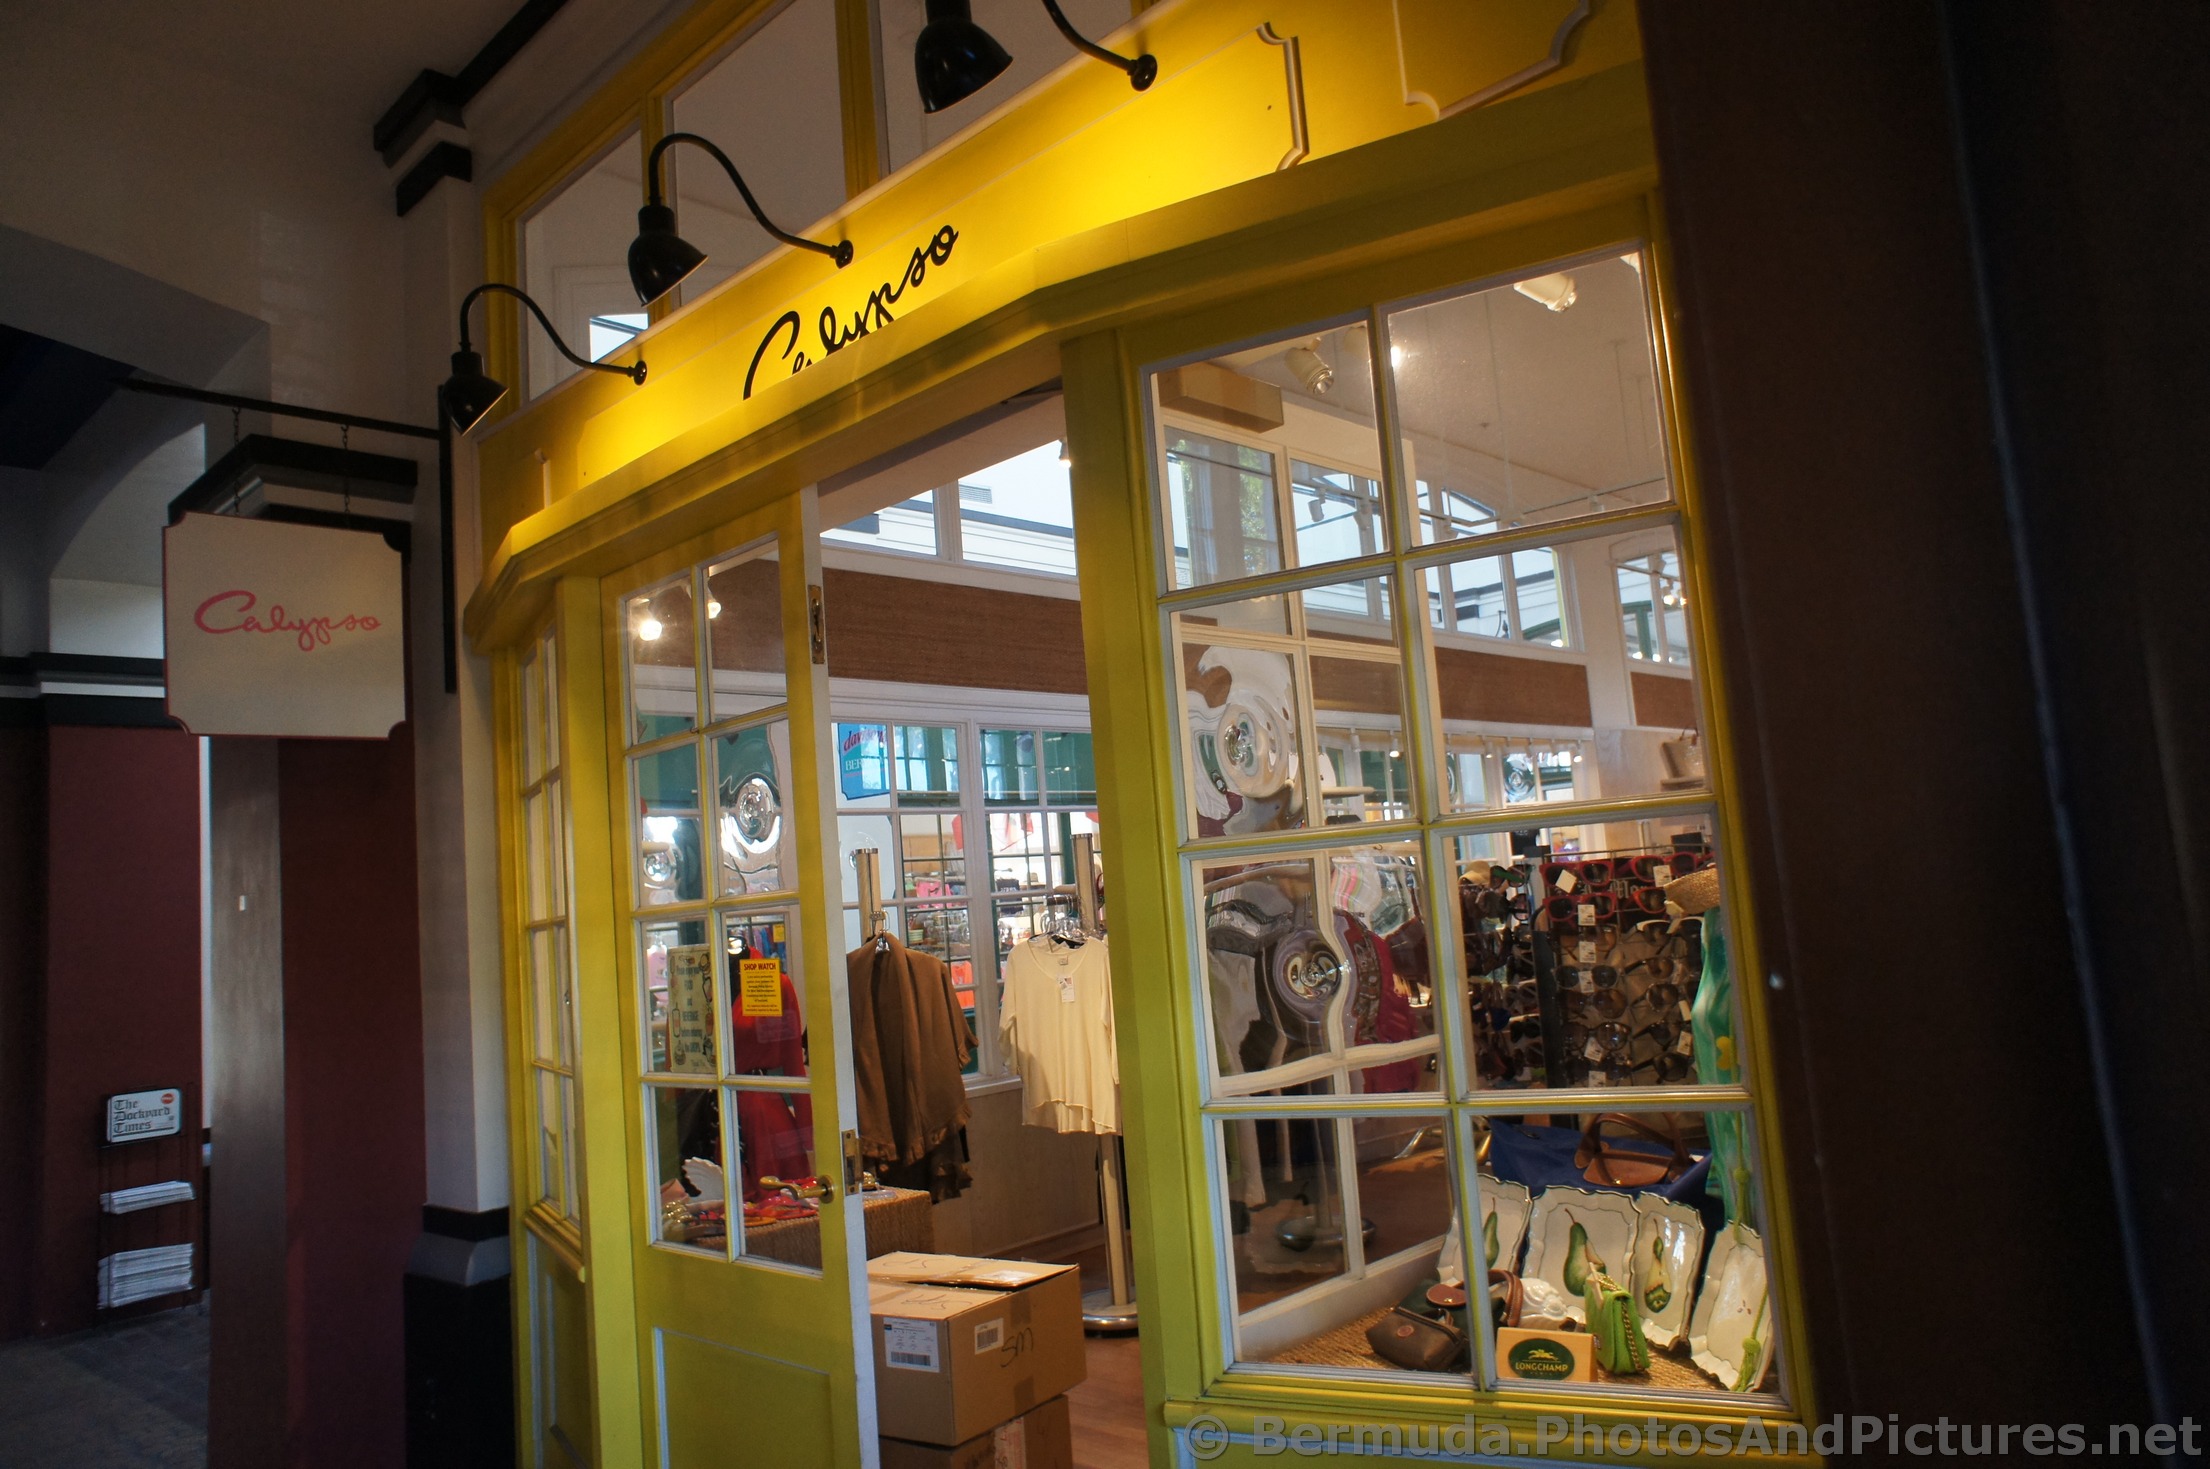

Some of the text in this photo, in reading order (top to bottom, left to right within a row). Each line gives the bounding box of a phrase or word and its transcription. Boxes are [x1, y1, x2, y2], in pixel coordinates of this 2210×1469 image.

[194, 590, 381, 651] Calypso
[744, 962, 777, 971] SHOP WATCH
[114, 1099, 138, 1111] The
[113, 1106, 171, 1121] Dockyard
[113, 1121, 152, 1133] Times
[1515, 1362, 1568, 1372] LONGCHAMP
